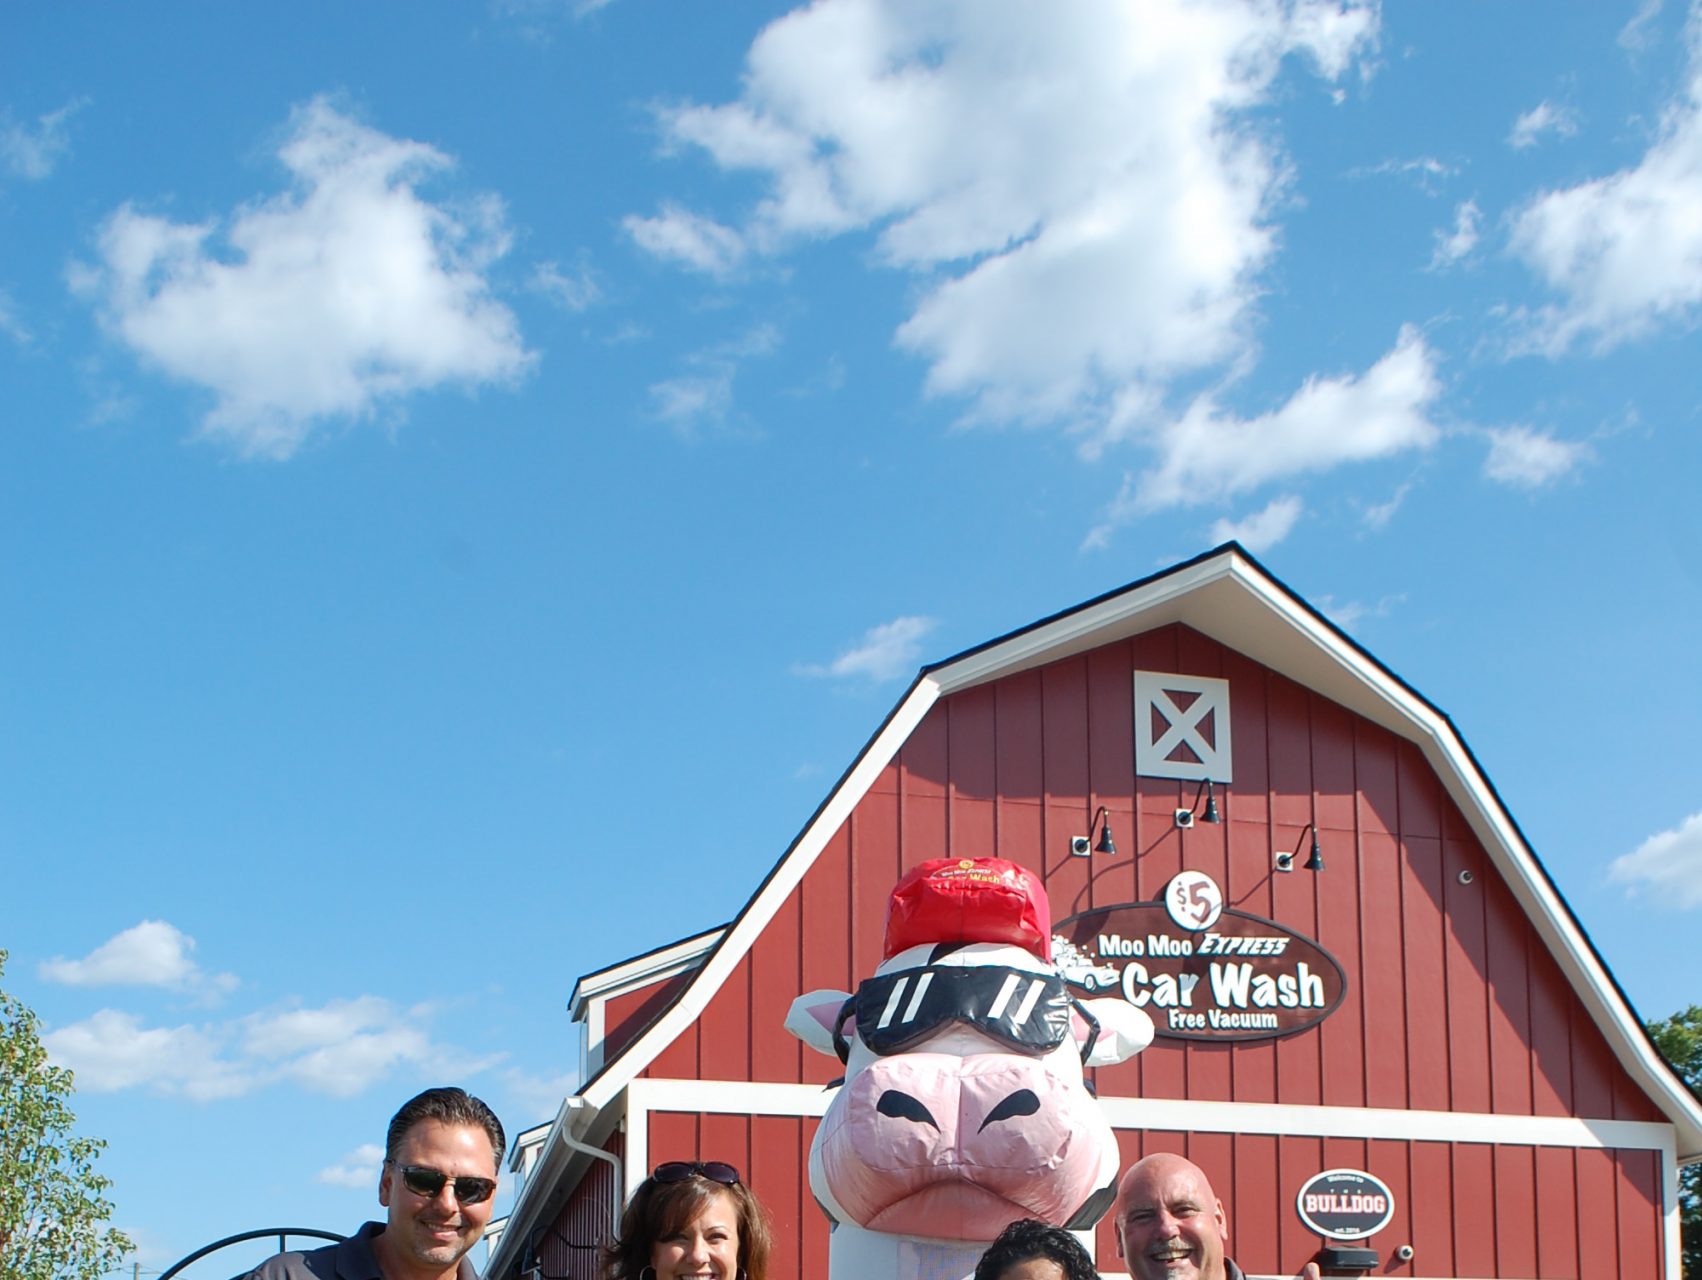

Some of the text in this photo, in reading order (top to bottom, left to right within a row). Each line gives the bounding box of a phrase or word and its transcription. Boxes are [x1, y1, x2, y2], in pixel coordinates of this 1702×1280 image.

[1176, 880, 1212, 923] $5
[1098, 934, 1143, 957] Moo
[1147, 934, 1192, 957] Moo
[1121, 961, 1326, 1008] Car Wash
[1169, 1009, 1278, 1029] Free Vacuum
[1305, 1194, 1386, 1214] BULLDOG
